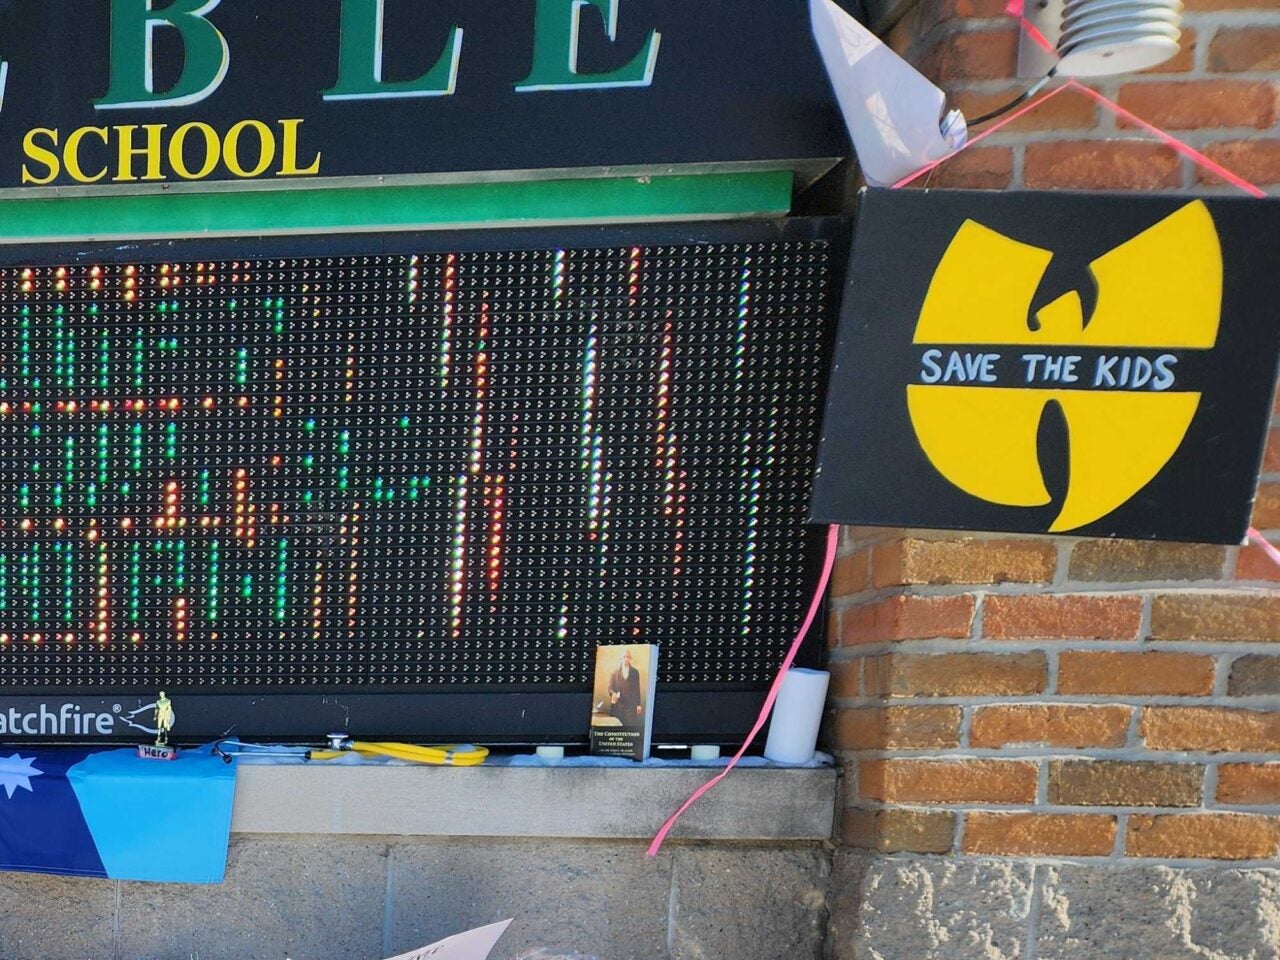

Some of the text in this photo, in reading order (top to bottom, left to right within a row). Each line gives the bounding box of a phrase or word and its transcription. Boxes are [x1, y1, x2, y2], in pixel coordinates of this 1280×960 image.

[21, 119, 321, 184] SCHOOL
[920, 350, 1178, 390] SAVE THE KIDS
[144, 747, 168, 758] Hero
